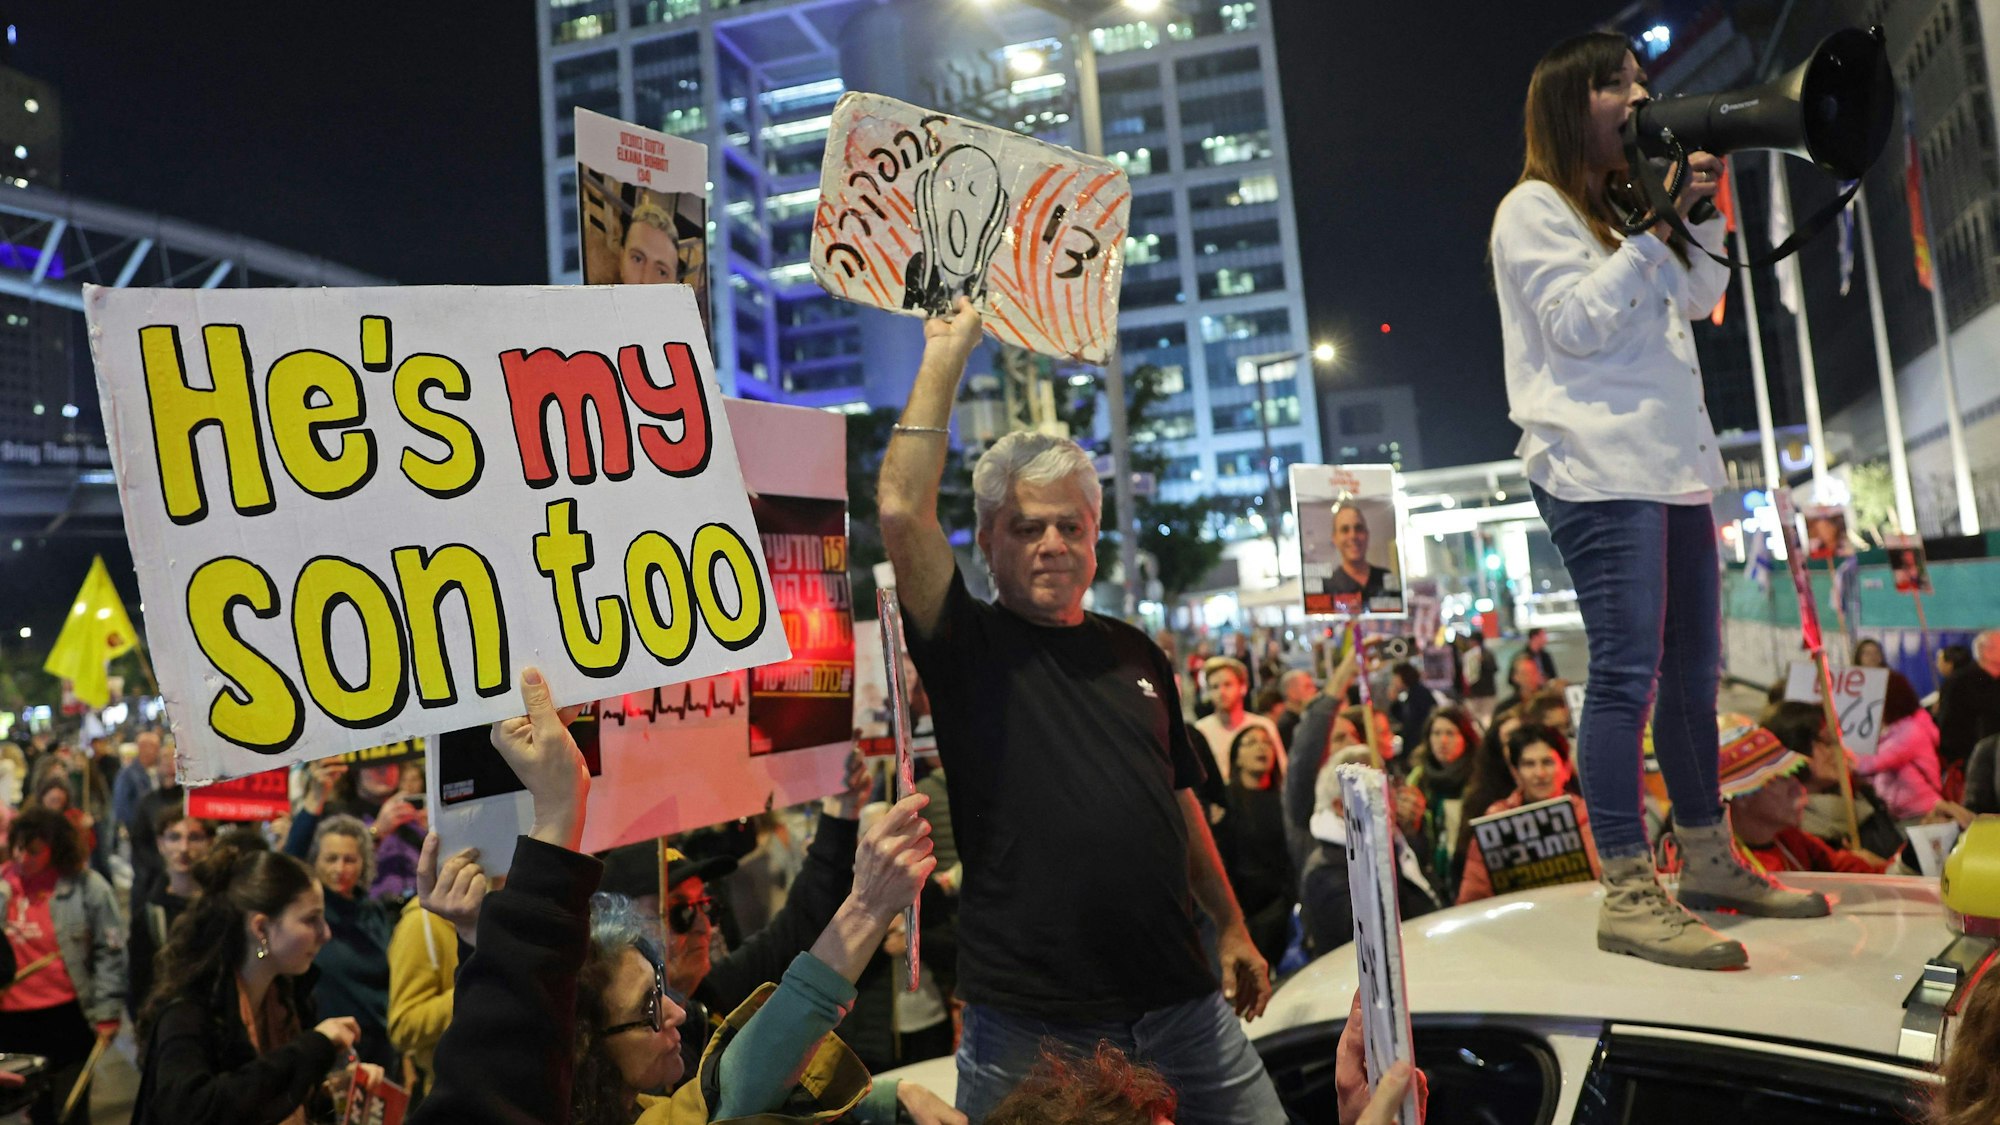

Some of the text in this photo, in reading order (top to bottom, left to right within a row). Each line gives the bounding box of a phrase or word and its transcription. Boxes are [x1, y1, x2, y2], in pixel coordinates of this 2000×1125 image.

[138, 315, 712, 525] He's my
[186, 497, 766, 754] son too
[1475, 803, 1576, 849] הימים
